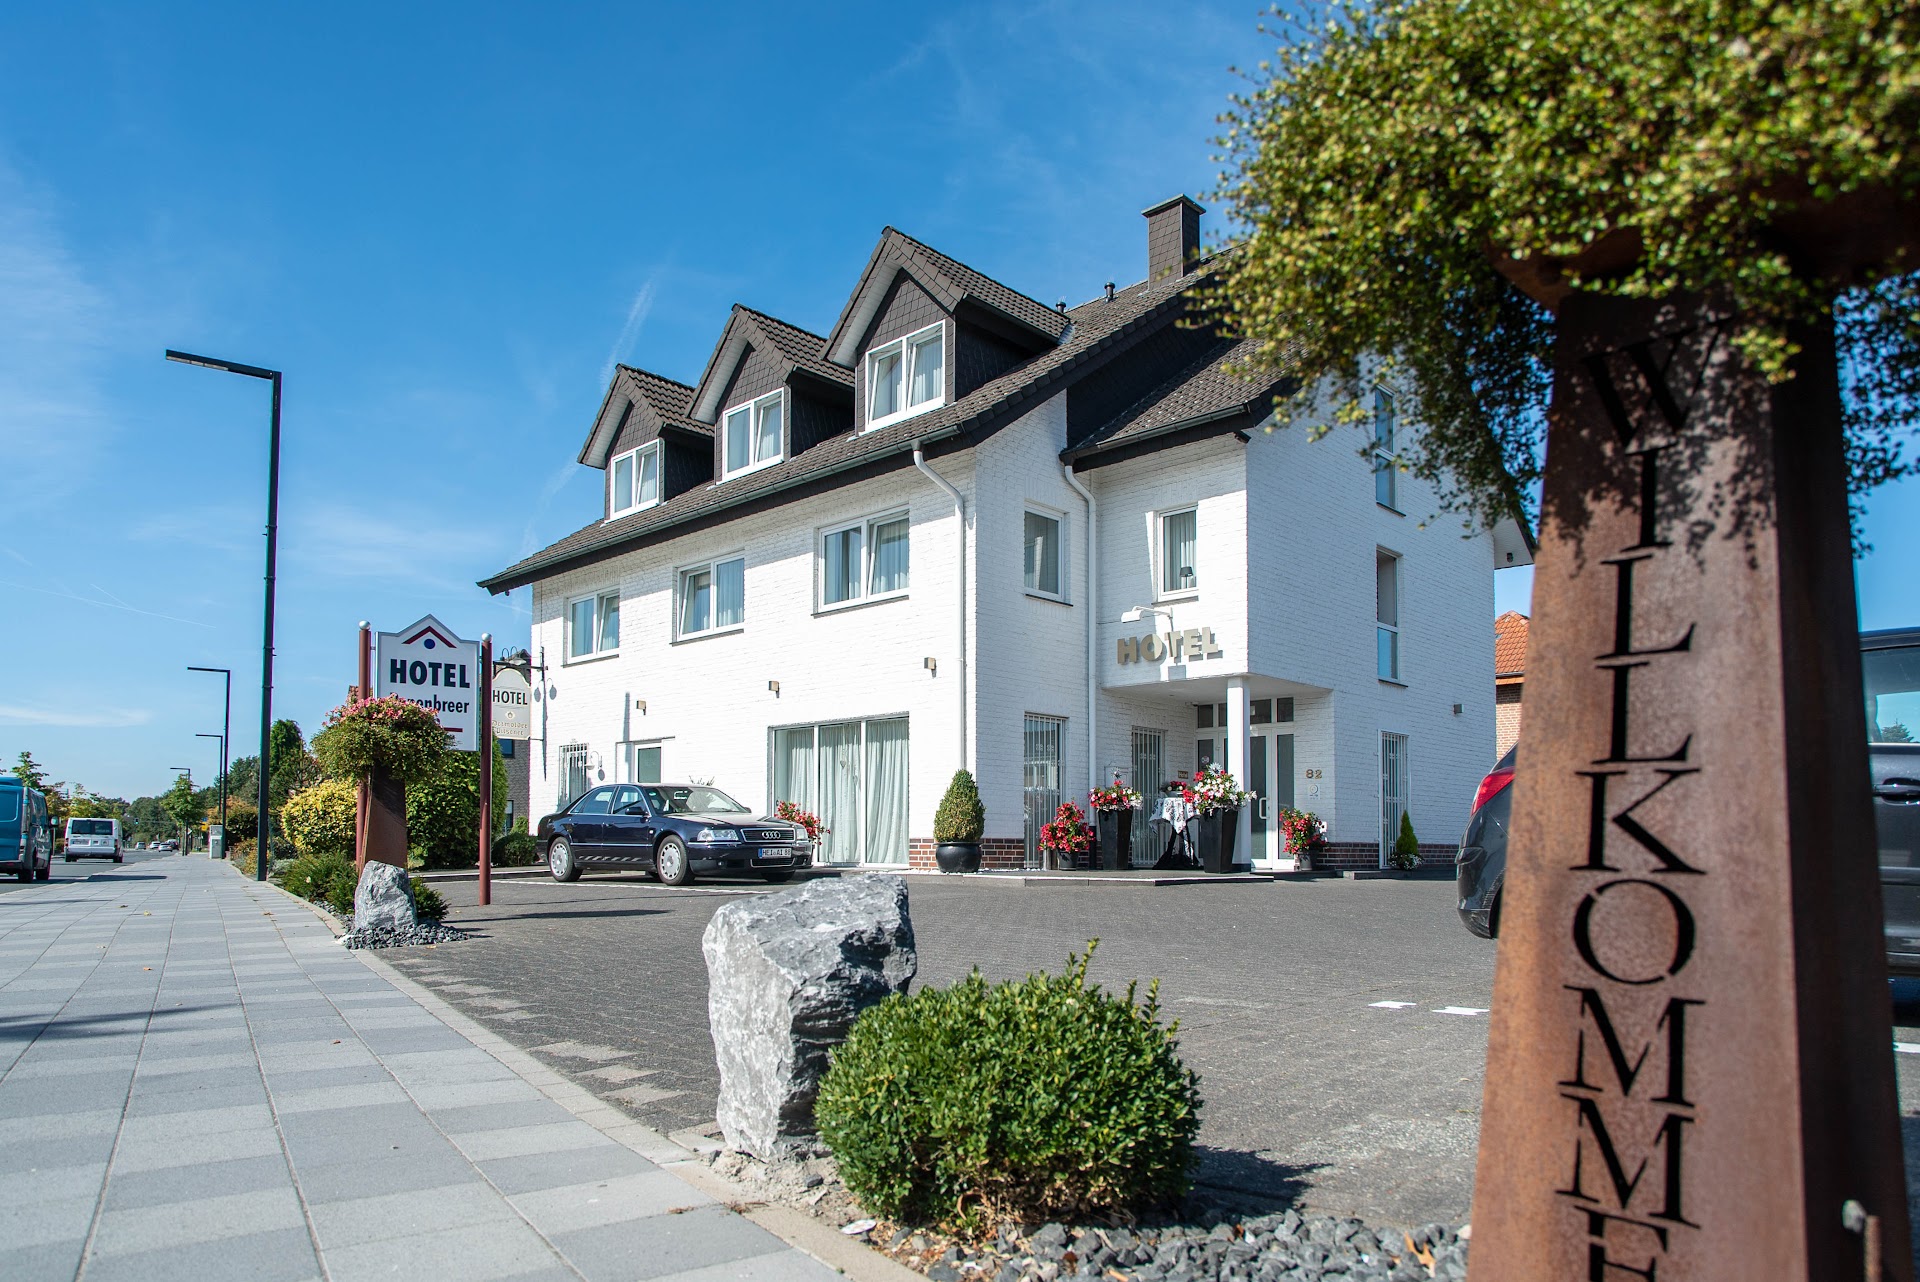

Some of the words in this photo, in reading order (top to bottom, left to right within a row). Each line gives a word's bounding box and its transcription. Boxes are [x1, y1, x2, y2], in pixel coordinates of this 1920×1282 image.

[1117, 626, 1220, 665] HOTEL
[390, 659, 470, 688] HOTEL
[492, 689, 528, 705] HOTEL
[1306, 768, 1323, 779] 82
